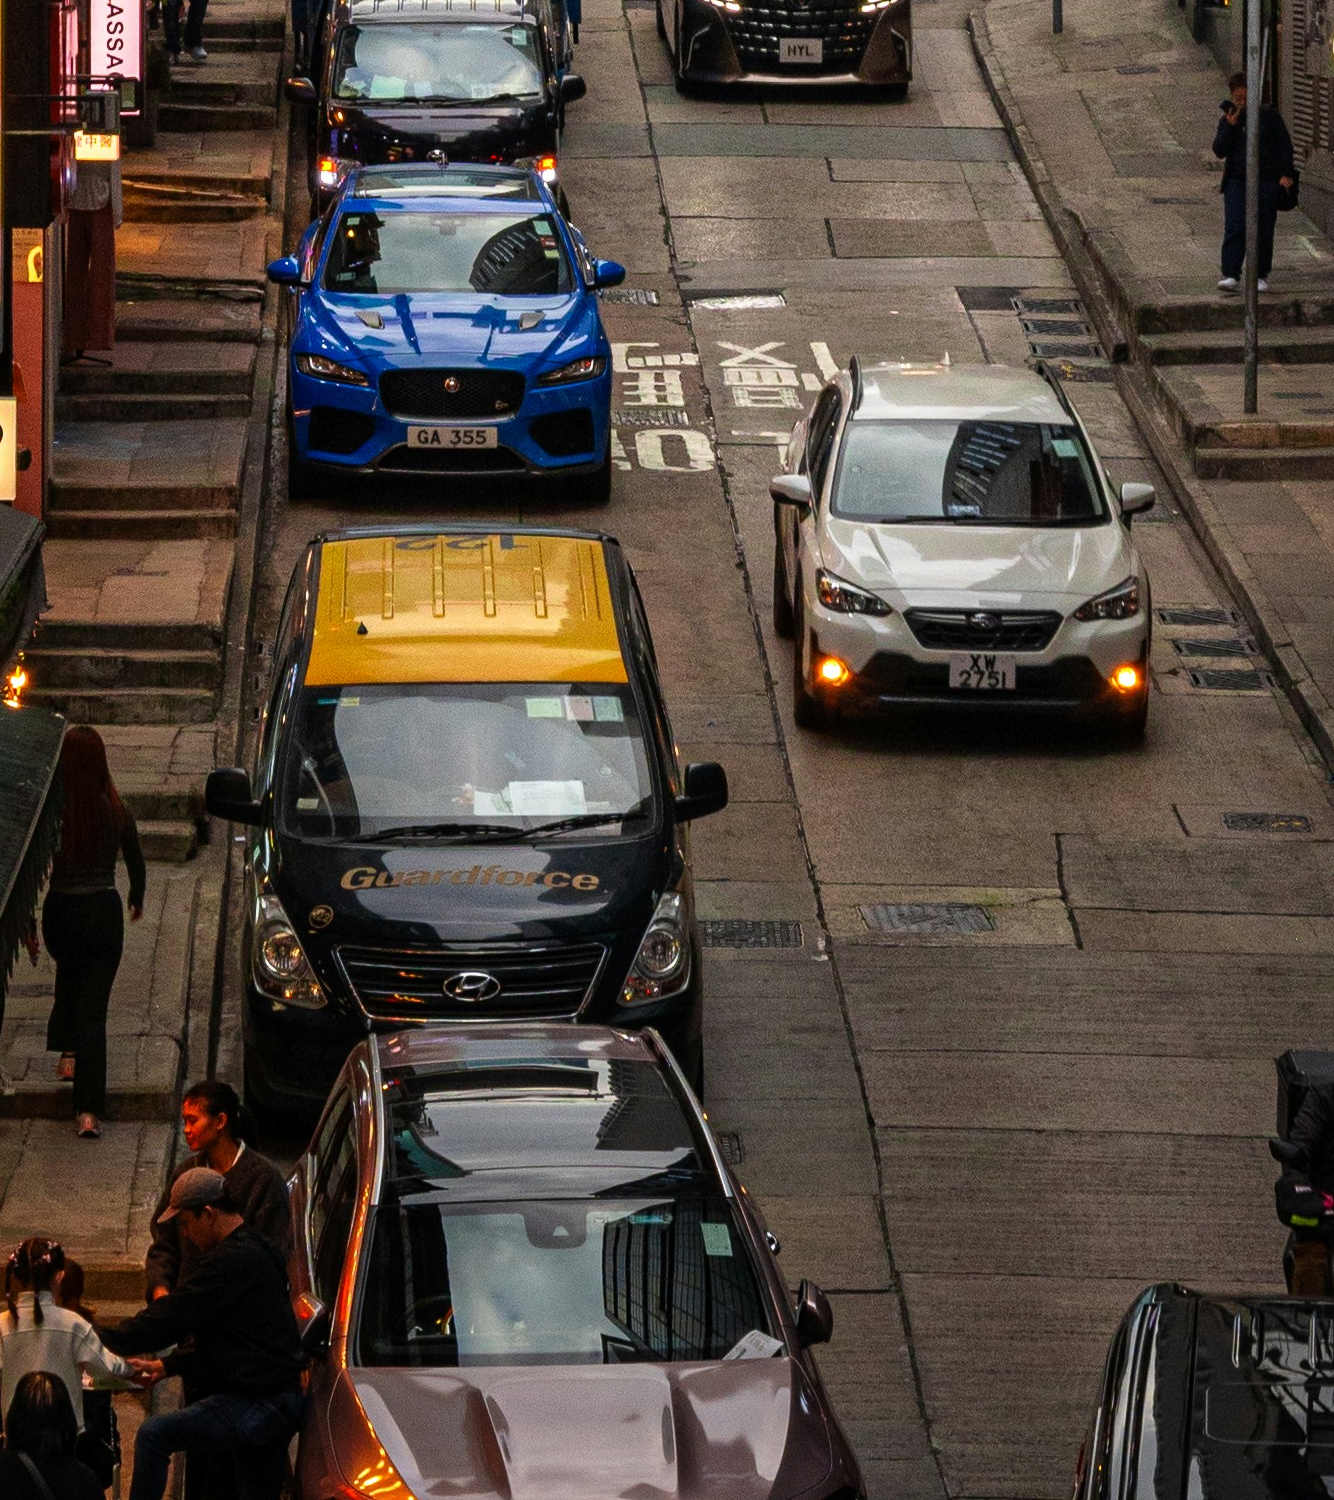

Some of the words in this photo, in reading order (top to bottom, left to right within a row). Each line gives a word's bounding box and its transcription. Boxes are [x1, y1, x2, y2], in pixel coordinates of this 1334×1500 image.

[417, 430, 441, 445] GA
[450, 430, 486, 445] 355
[971, 654, 996, 671] XW
[959, 670, 1006, 688] 2751
[340, 865, 601, 891] Guardforce
